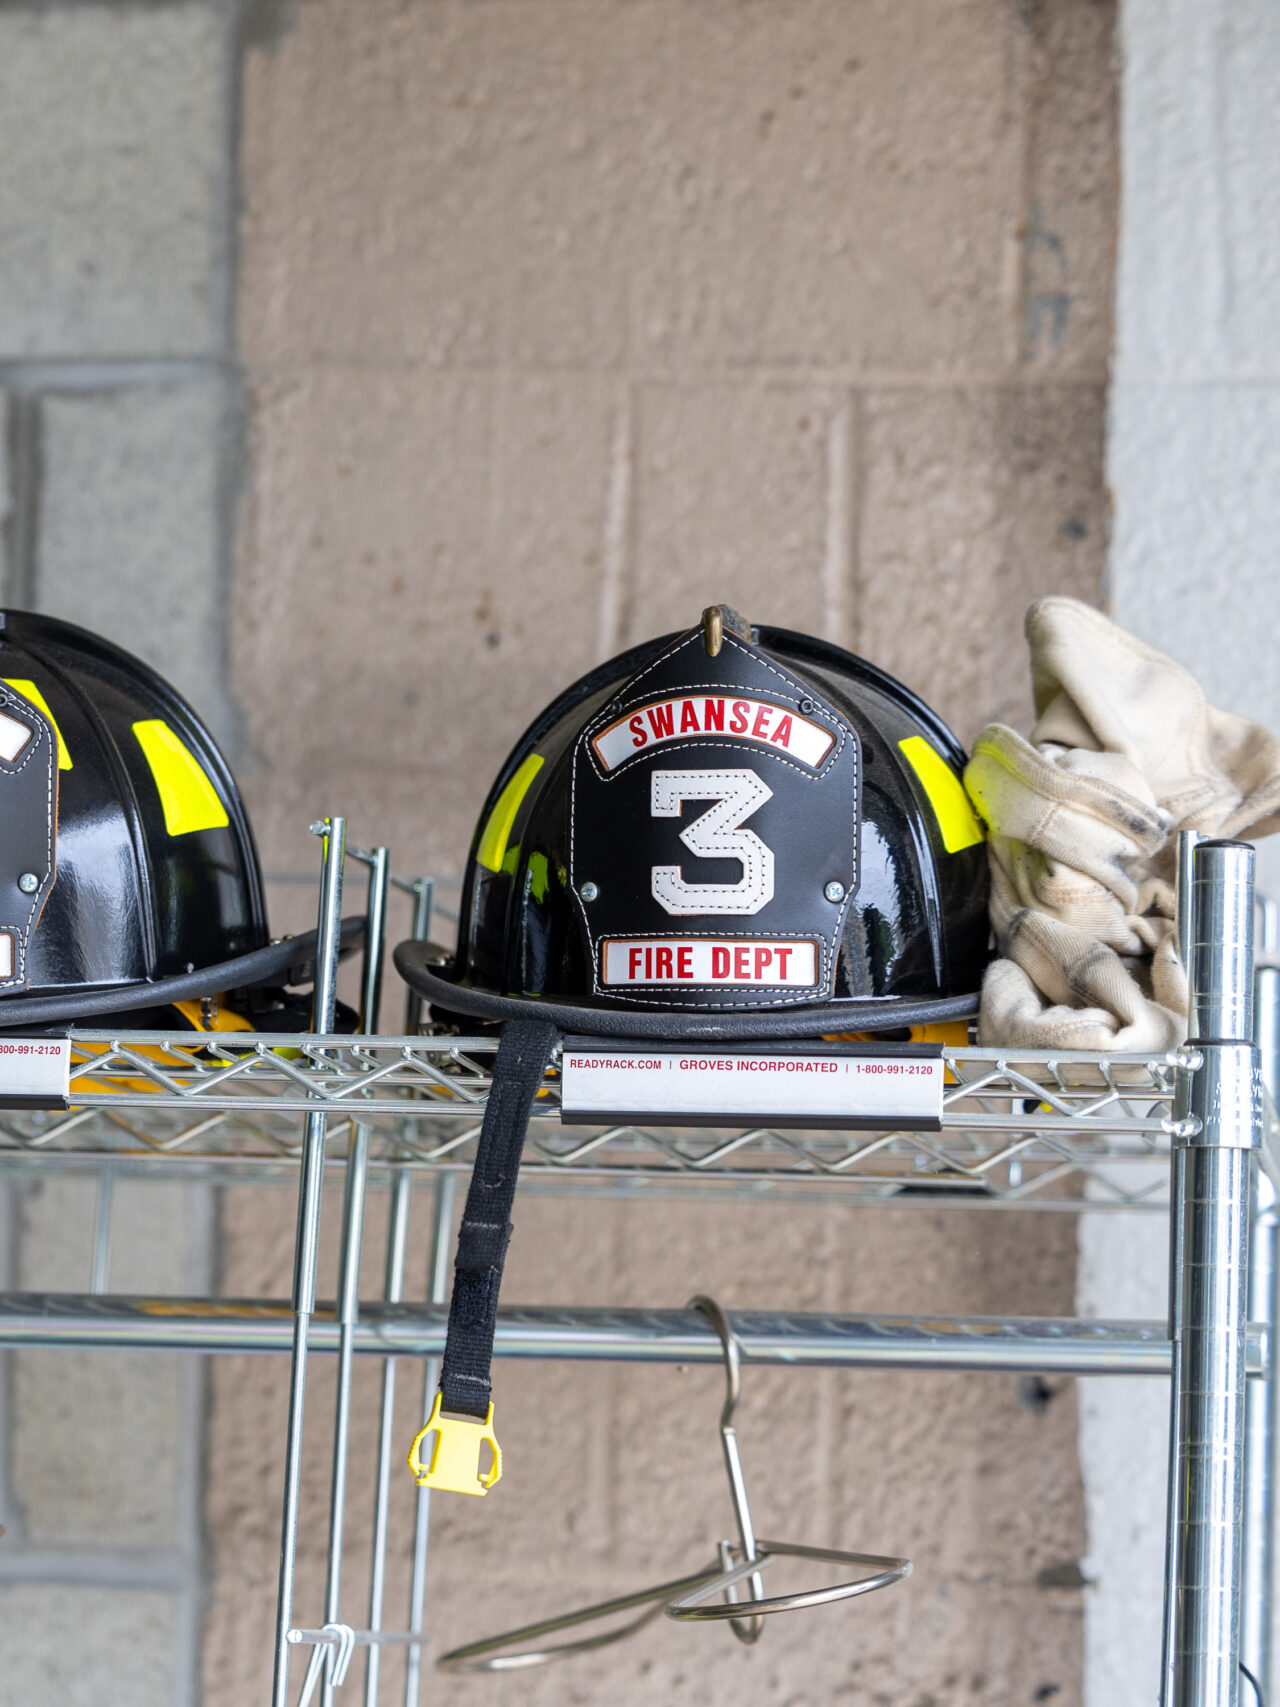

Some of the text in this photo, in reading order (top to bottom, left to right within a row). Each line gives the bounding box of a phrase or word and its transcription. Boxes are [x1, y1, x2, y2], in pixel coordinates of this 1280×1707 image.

[628, 699, 793, 748] SWANSEA
[651, 768, 775, 916] 3
[628, 946, 793, 980] FIRE DEPT
[570, 1058, 933, 1076] READYRACK.COM GROVES INCORPORATED 1-800-991-2120
